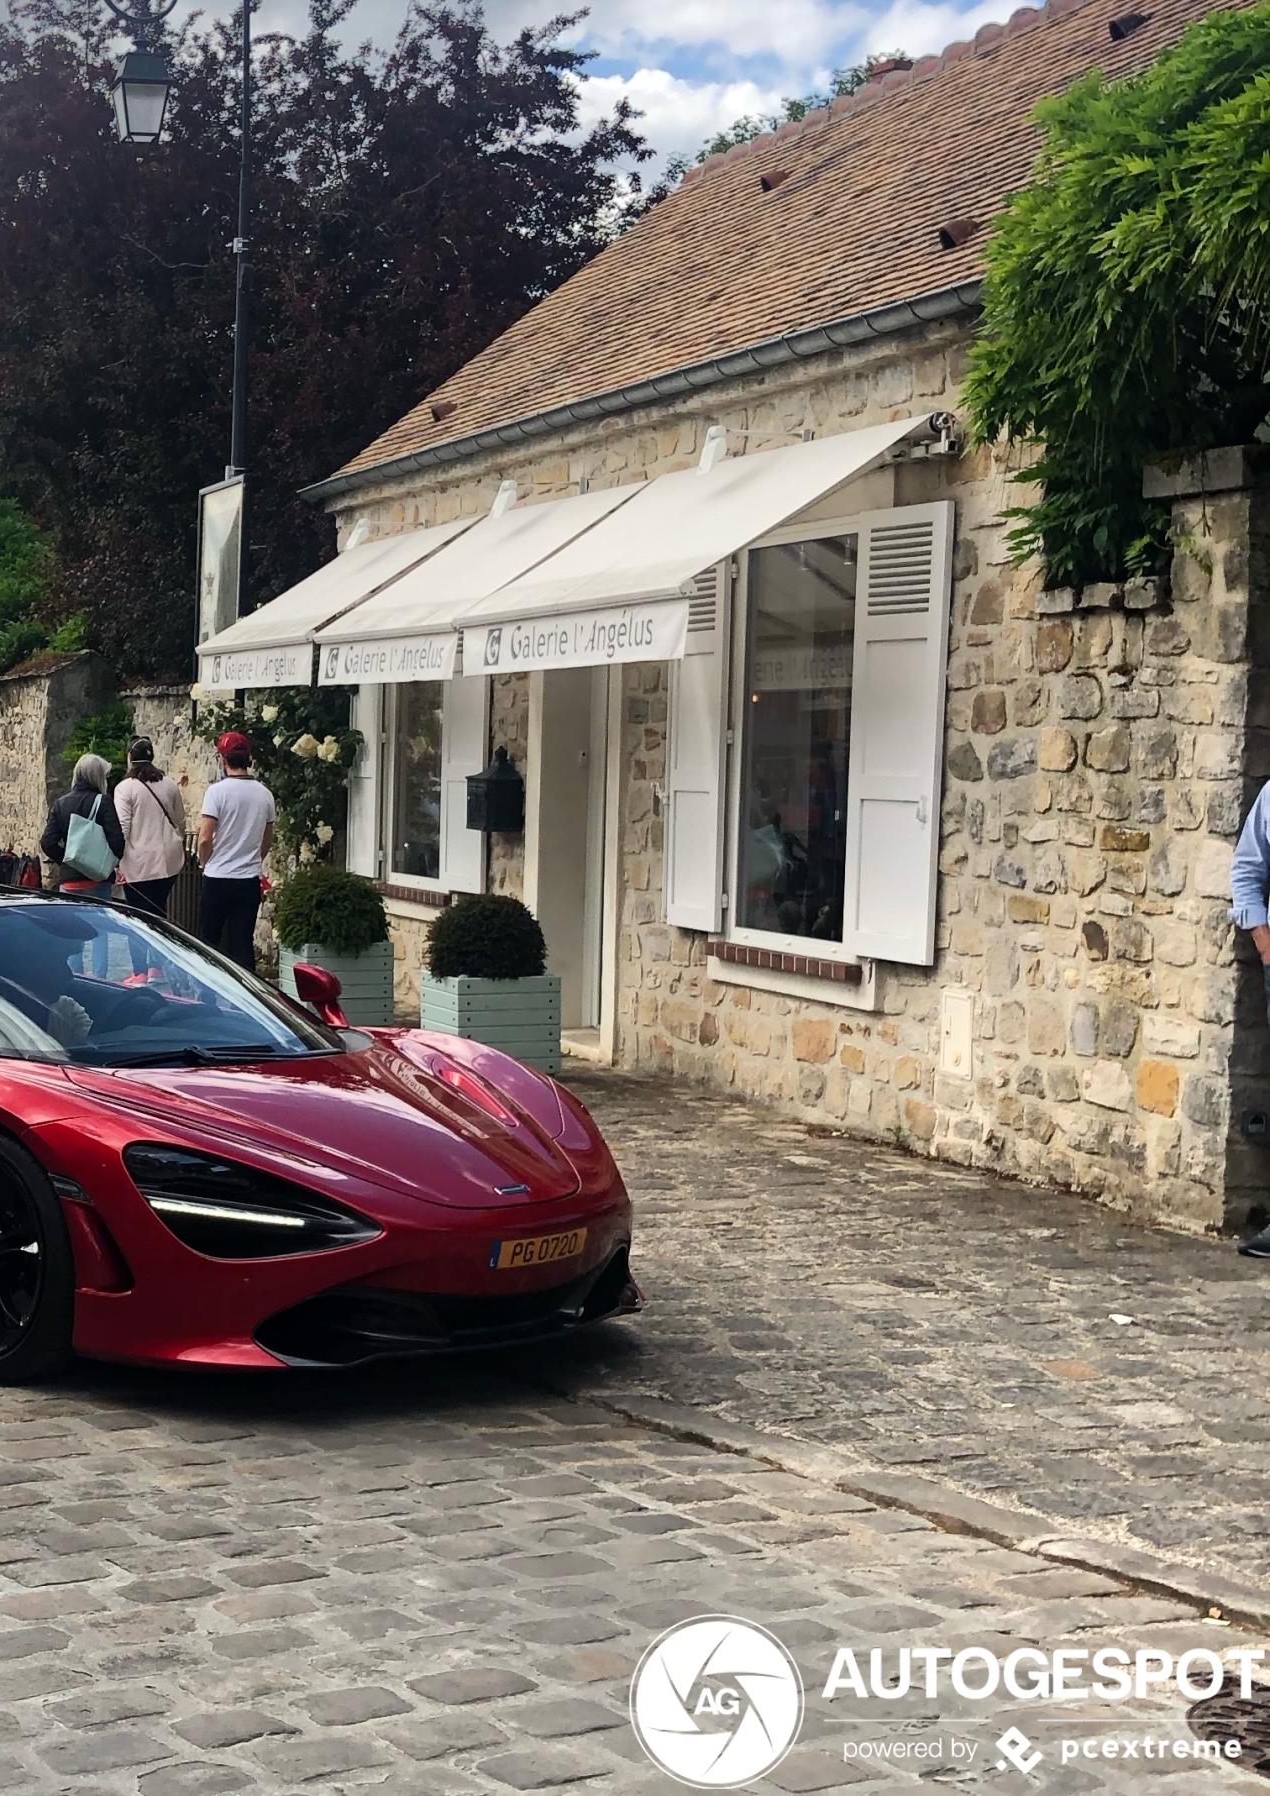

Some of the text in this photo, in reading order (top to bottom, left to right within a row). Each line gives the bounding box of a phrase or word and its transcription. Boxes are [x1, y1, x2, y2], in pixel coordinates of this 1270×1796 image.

[510, 624, 568, 660] Galerie
[225, 655, 253, 680] Galerie
[344, 645, 387, 675] Galerie
[510, 1241, 535, 1265] PG
[537, 1232, 579, 1261] 0720
